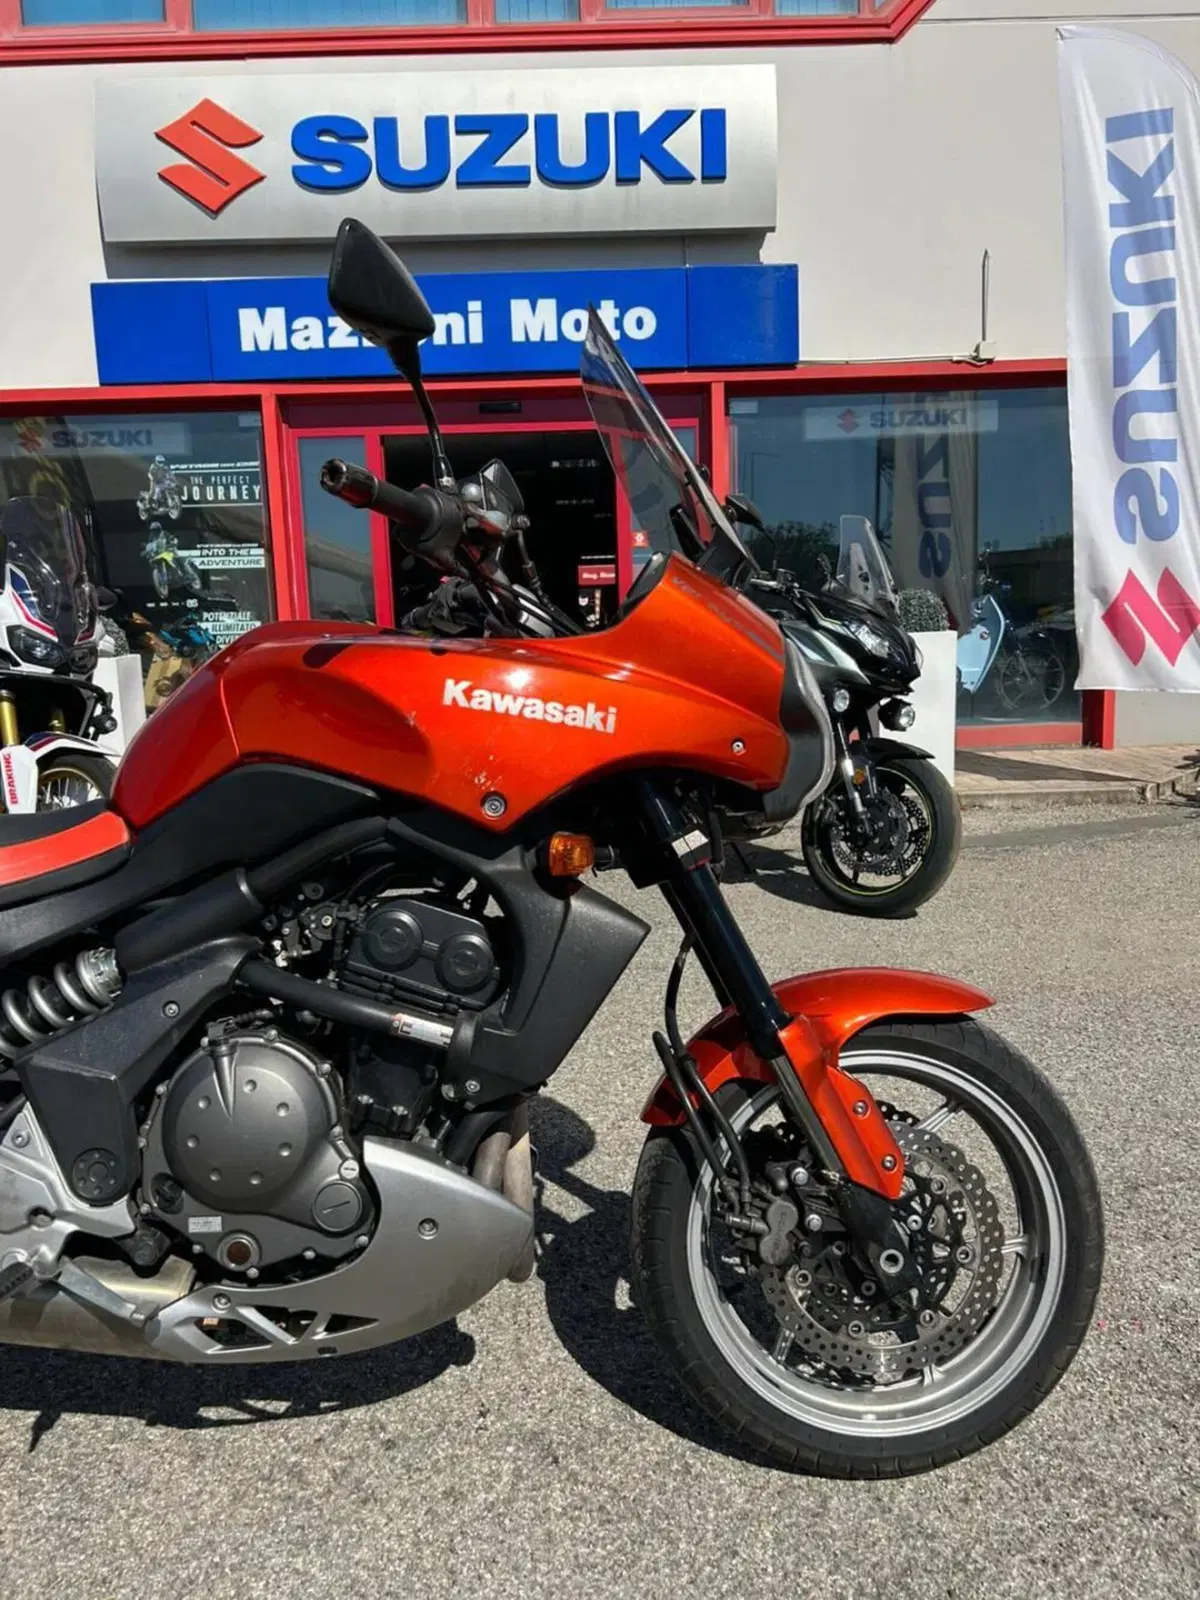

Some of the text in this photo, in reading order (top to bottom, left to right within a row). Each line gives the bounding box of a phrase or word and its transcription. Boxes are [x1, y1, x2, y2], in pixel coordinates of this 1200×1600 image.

[290, 108, 727, 190] SUZUKI
[238, 298, 657, 352] Mazni Moto
[870, 408, 967, 428] SUZUKI
[52, 429, 153, 448] SUZUKI
[211, 475, 250, 484] PERFECT
[181, 485, 260, 501] JOURNEY
[202, 548, 250, 556] INTO THE
[199, 559, 262, 567] ADVENTURE
[202, 611, 251, 621] POTENZIALE
[442, 677, 618, 735] Kawasaki
[3, 753, 19, 805] BRAKING
